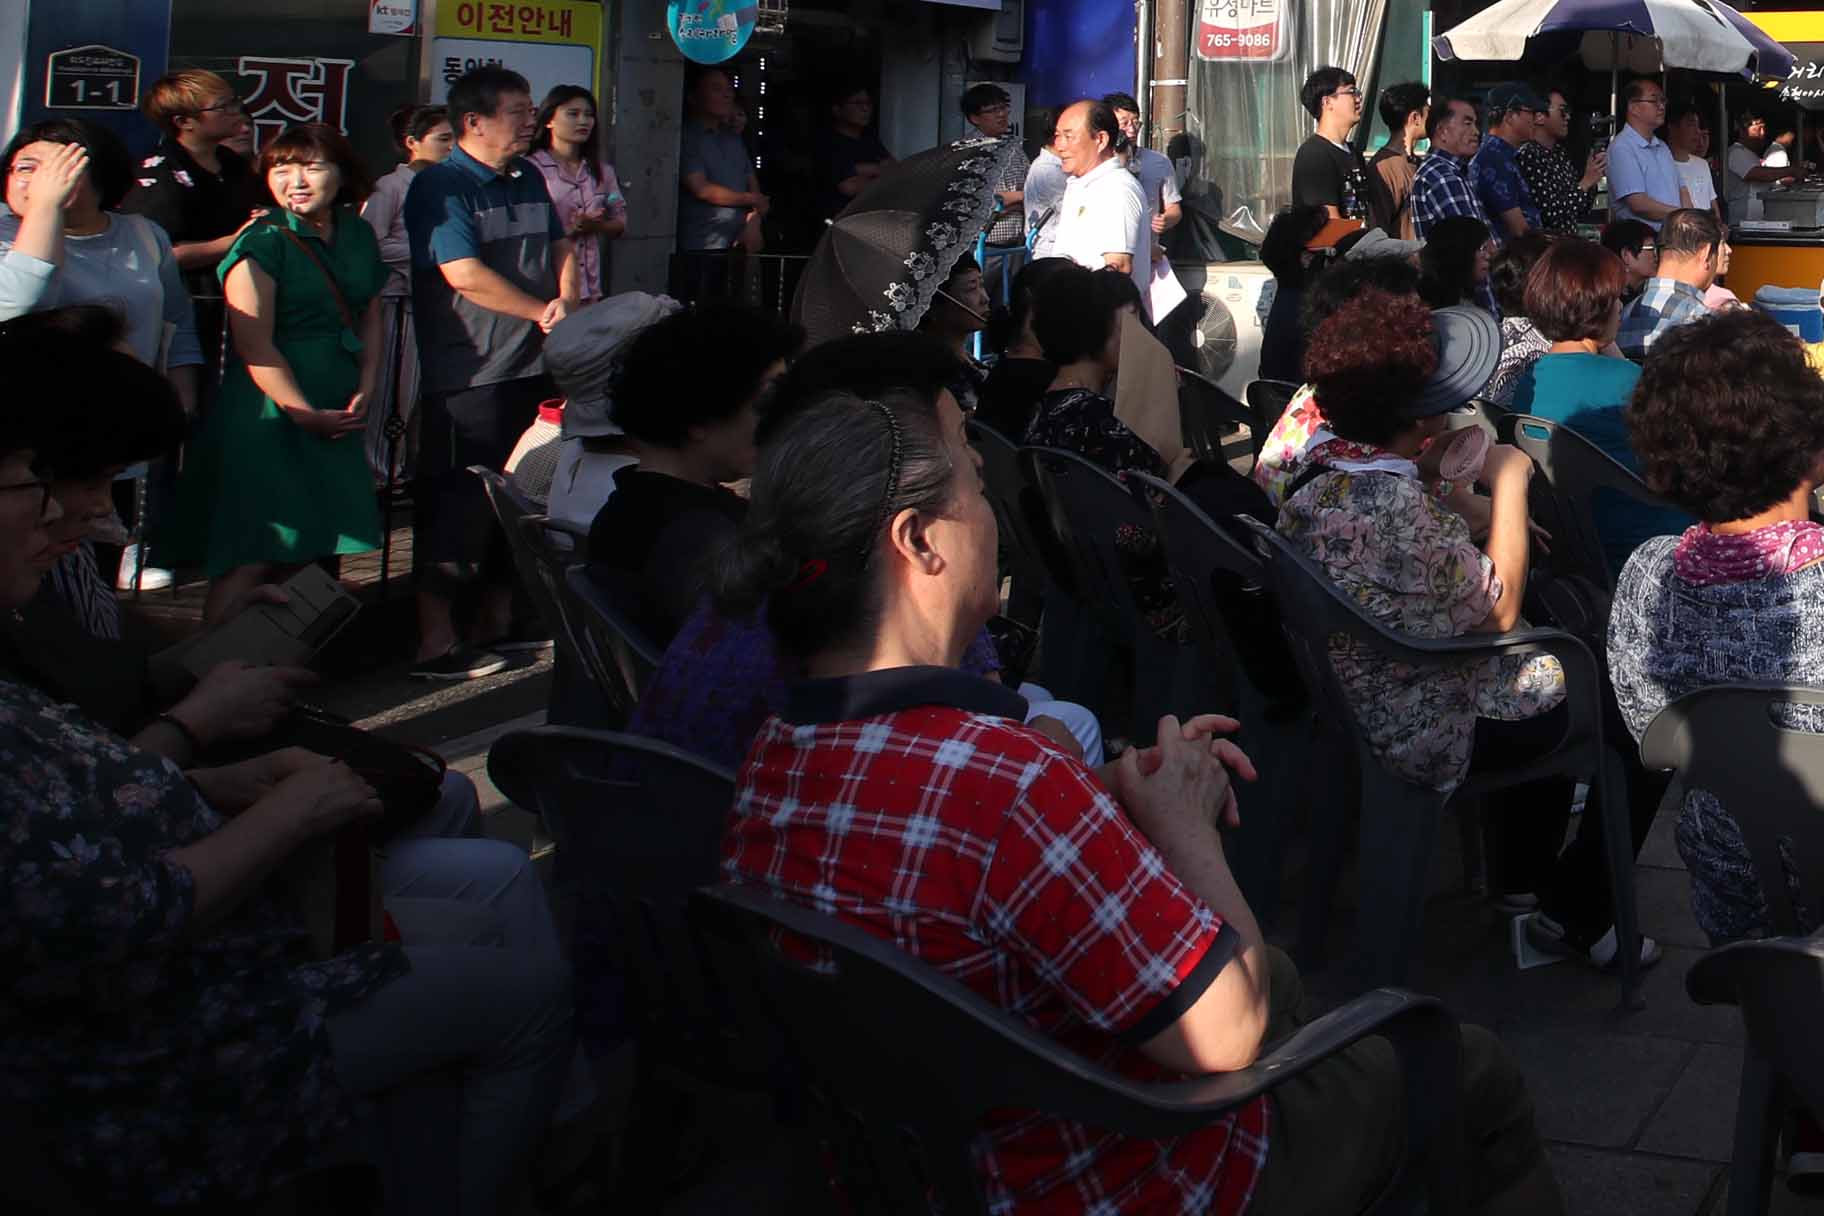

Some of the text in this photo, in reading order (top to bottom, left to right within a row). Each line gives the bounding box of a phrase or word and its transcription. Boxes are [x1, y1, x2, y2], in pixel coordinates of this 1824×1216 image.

[457, 1, 574, 38] 이전안내
[1207, 33, 1271, 48] 765-9086
[69, 79, 120, 103] 1-1
